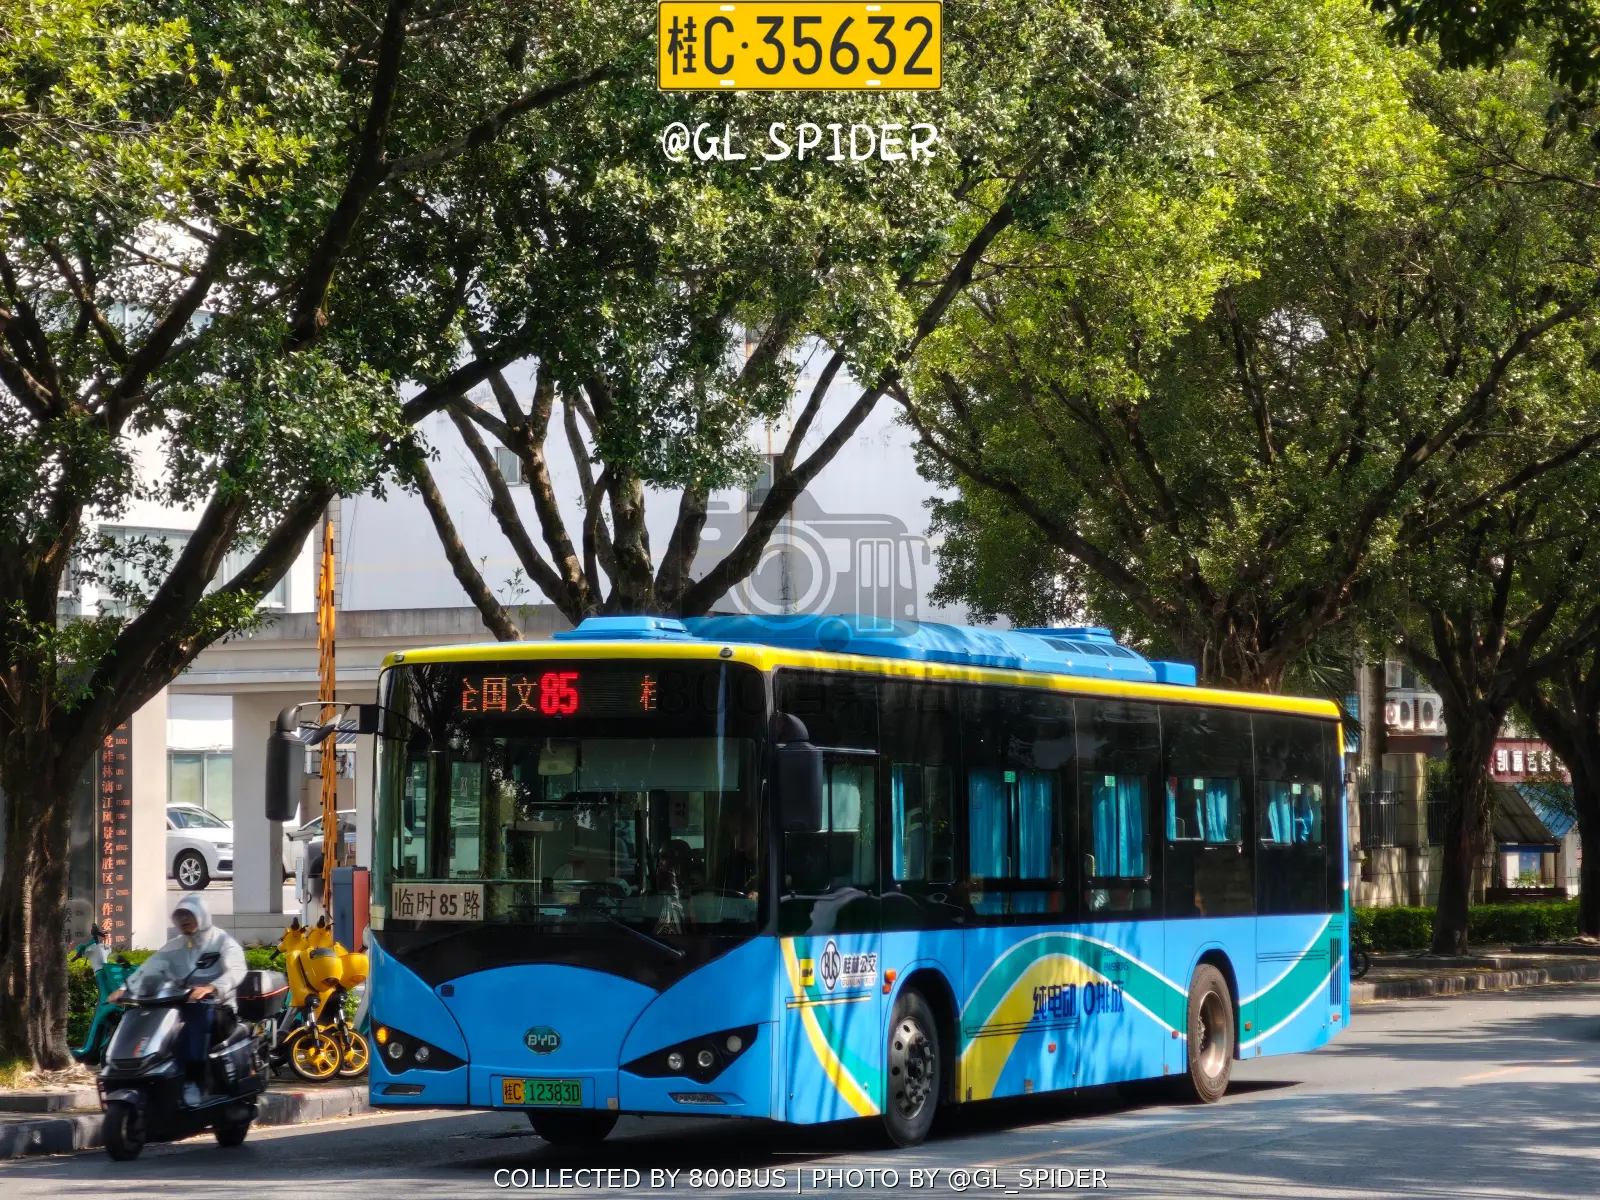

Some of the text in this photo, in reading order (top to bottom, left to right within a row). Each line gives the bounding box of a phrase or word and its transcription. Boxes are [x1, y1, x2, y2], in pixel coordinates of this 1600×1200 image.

[541, 672, 578, 714] 85
[394, 887, 480, 919] 临时85路
[527, 1034, 558, 1046] BYD
